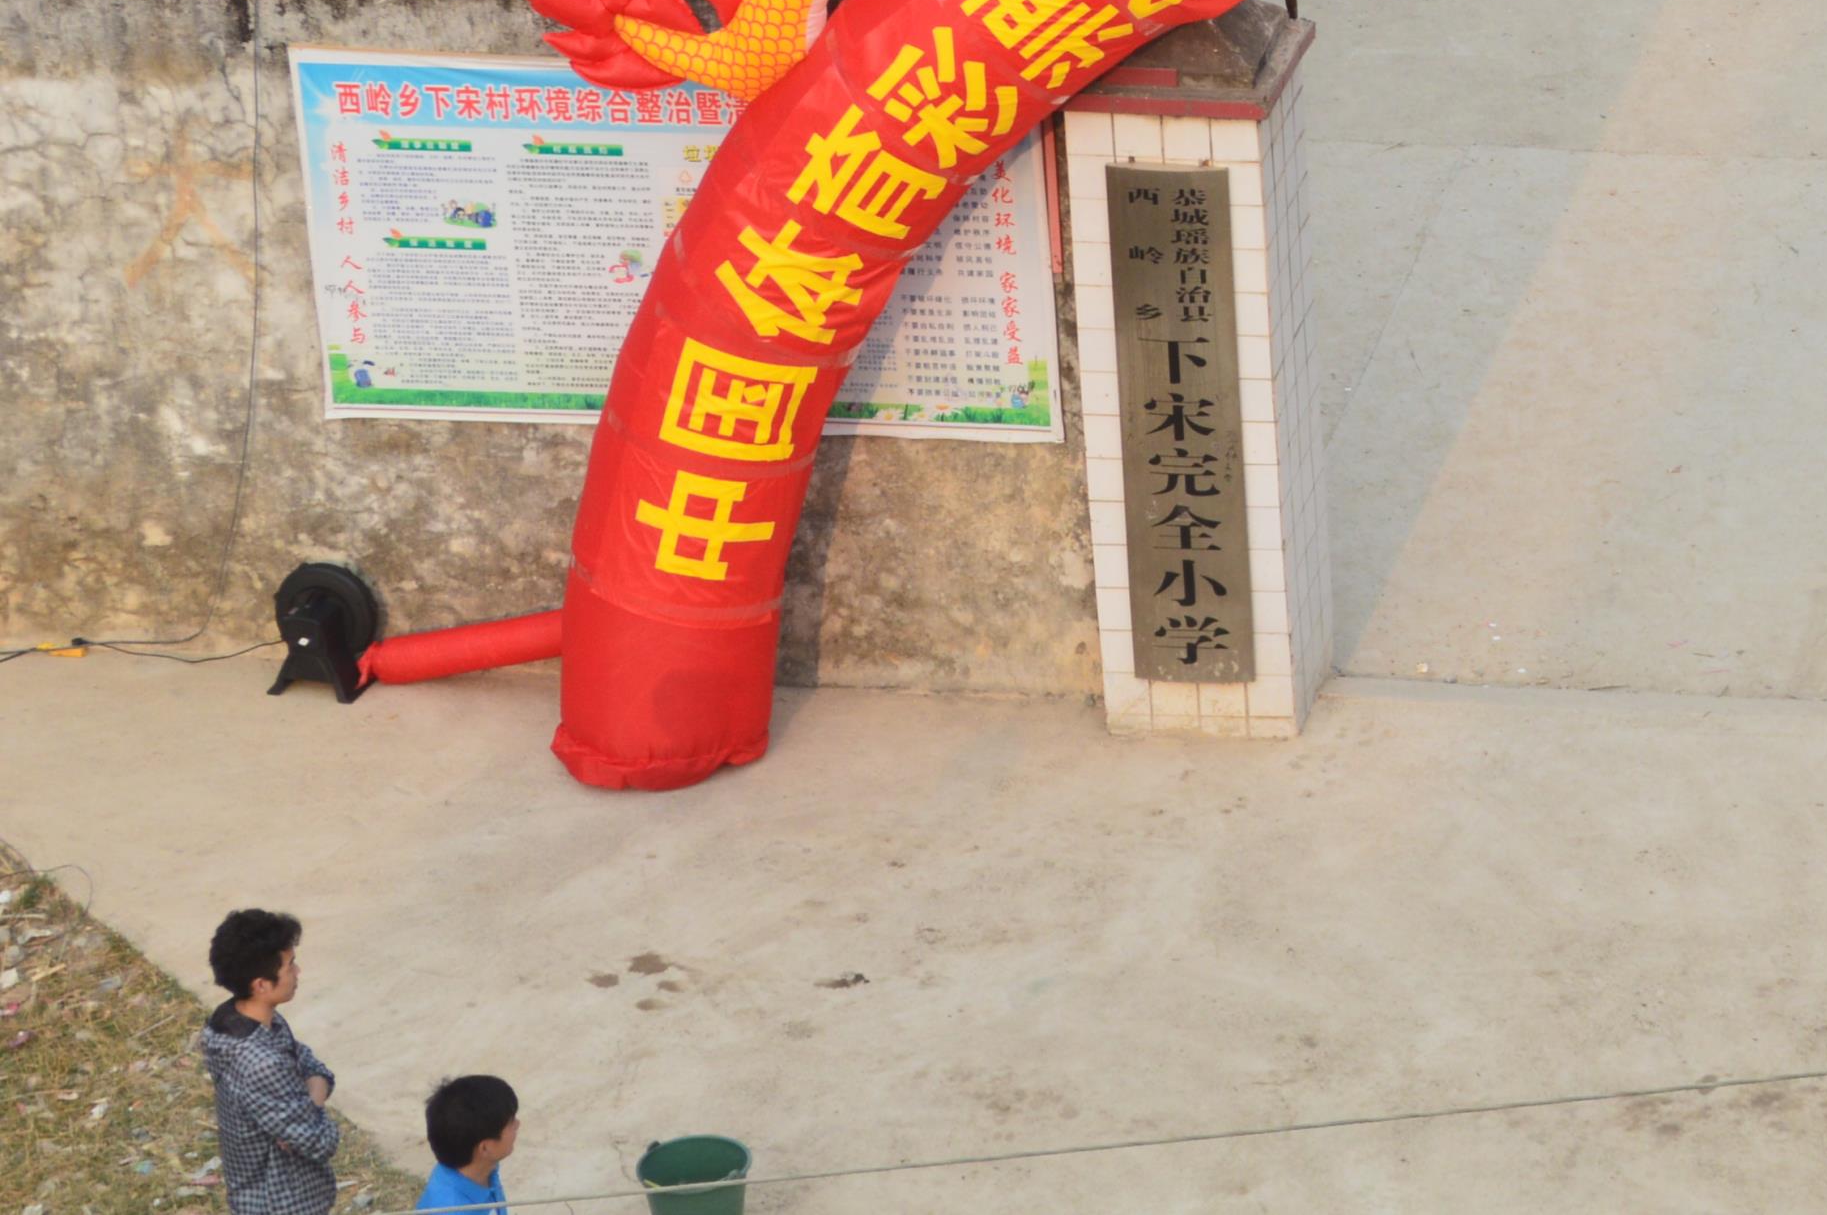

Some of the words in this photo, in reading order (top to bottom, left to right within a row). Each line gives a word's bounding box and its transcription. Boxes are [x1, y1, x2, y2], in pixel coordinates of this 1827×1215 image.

[330, 141, 354, 235] 清洁乡村
[991, 160, 1017, 256] 美化环境
[340, 254, 368, 345] 人人参与
[1127, 186, 1165, 321] 西岭乡
[1170, 187, 1212, 324] 恭城瑶族自治县
[999, 270, 1023, 366] 家家受益
[1137, 336, 1232, 666] 下宋完全小学
